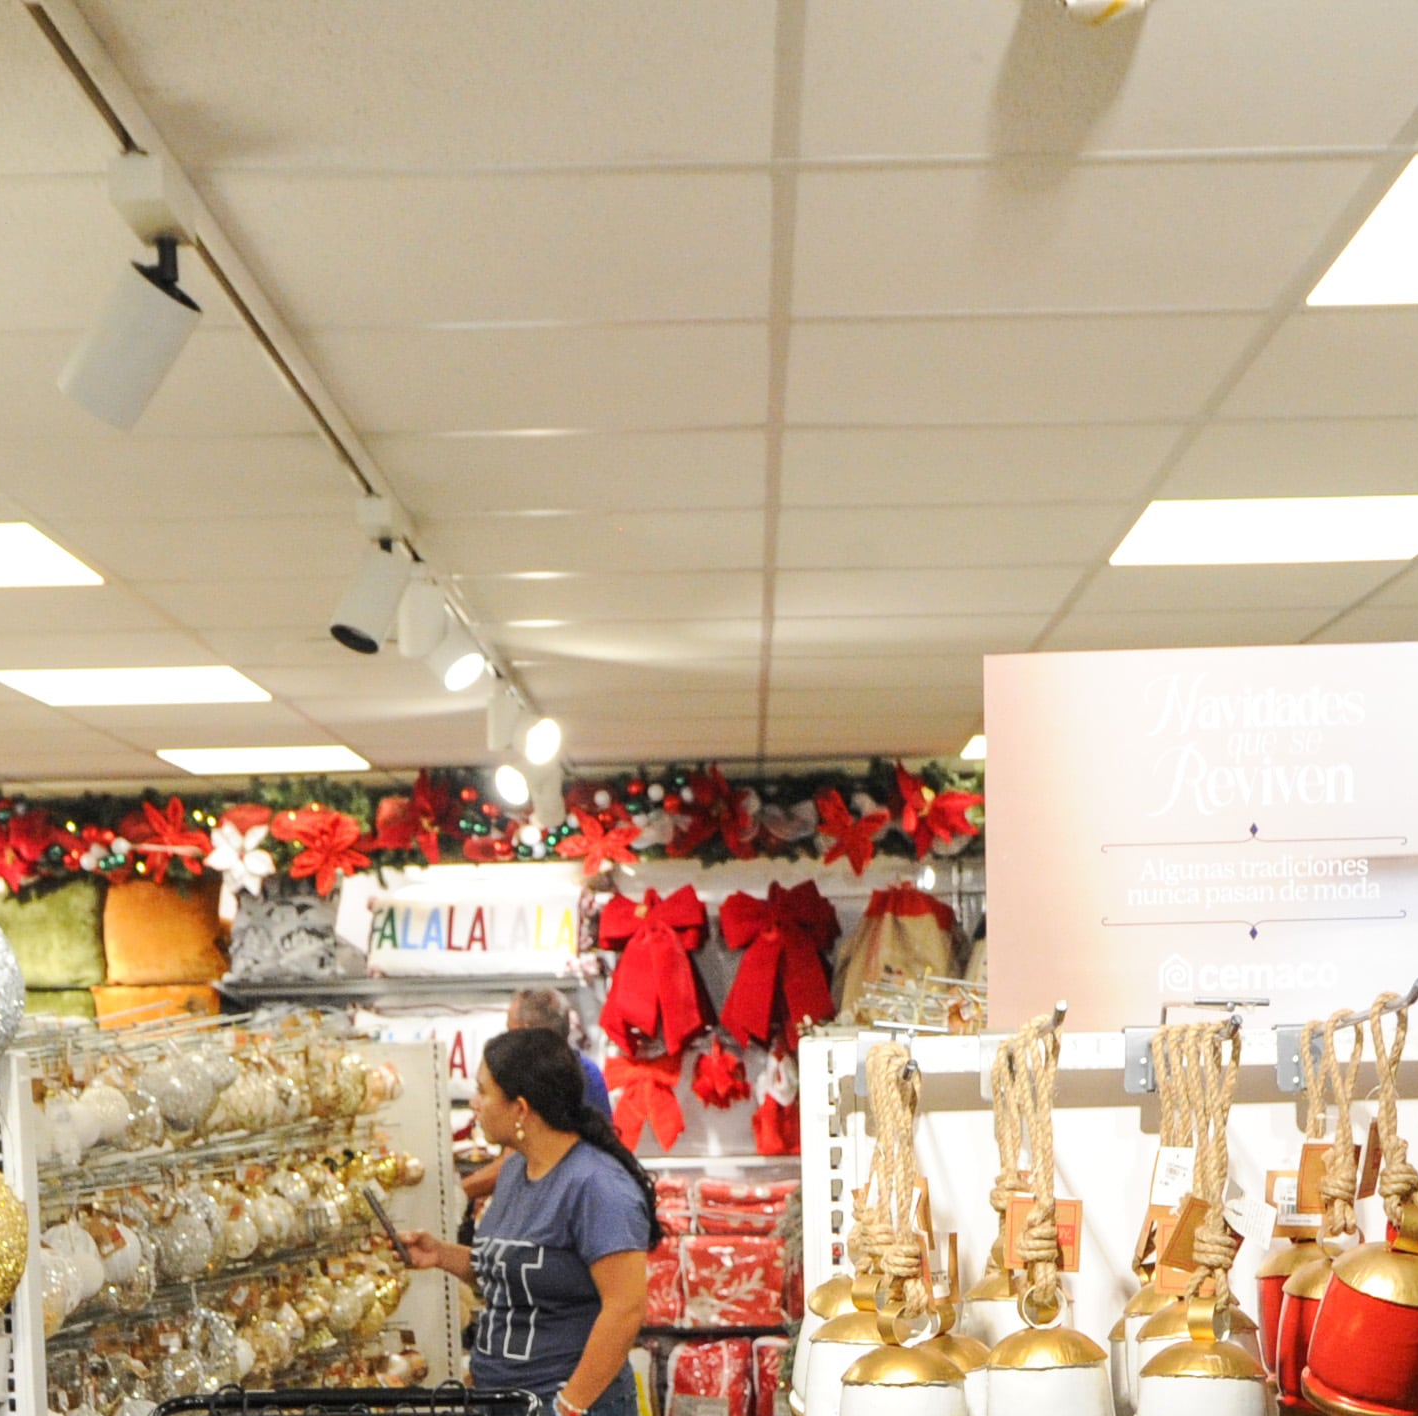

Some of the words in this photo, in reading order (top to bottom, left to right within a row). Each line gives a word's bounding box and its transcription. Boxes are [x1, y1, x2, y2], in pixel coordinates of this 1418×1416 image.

[1141, 672, 1366, 736] Navidades
[1227, 731, 1277, 758] que
[1289, 729, 1324, 755] se
[1141, 742, 1356, 817] Reviven
[1140, 858, 1236, 886] Algunas
[1241, 855, 1369, 880] tradiciones
[1127, 885, 1199, 906] nunca
[1205, 882, 1275, 912] pasan
[1280, 880, 1308, 902] de
[1314, 878, 1381, 901] moda
[1197, 960, 1339, 992] cemaco
